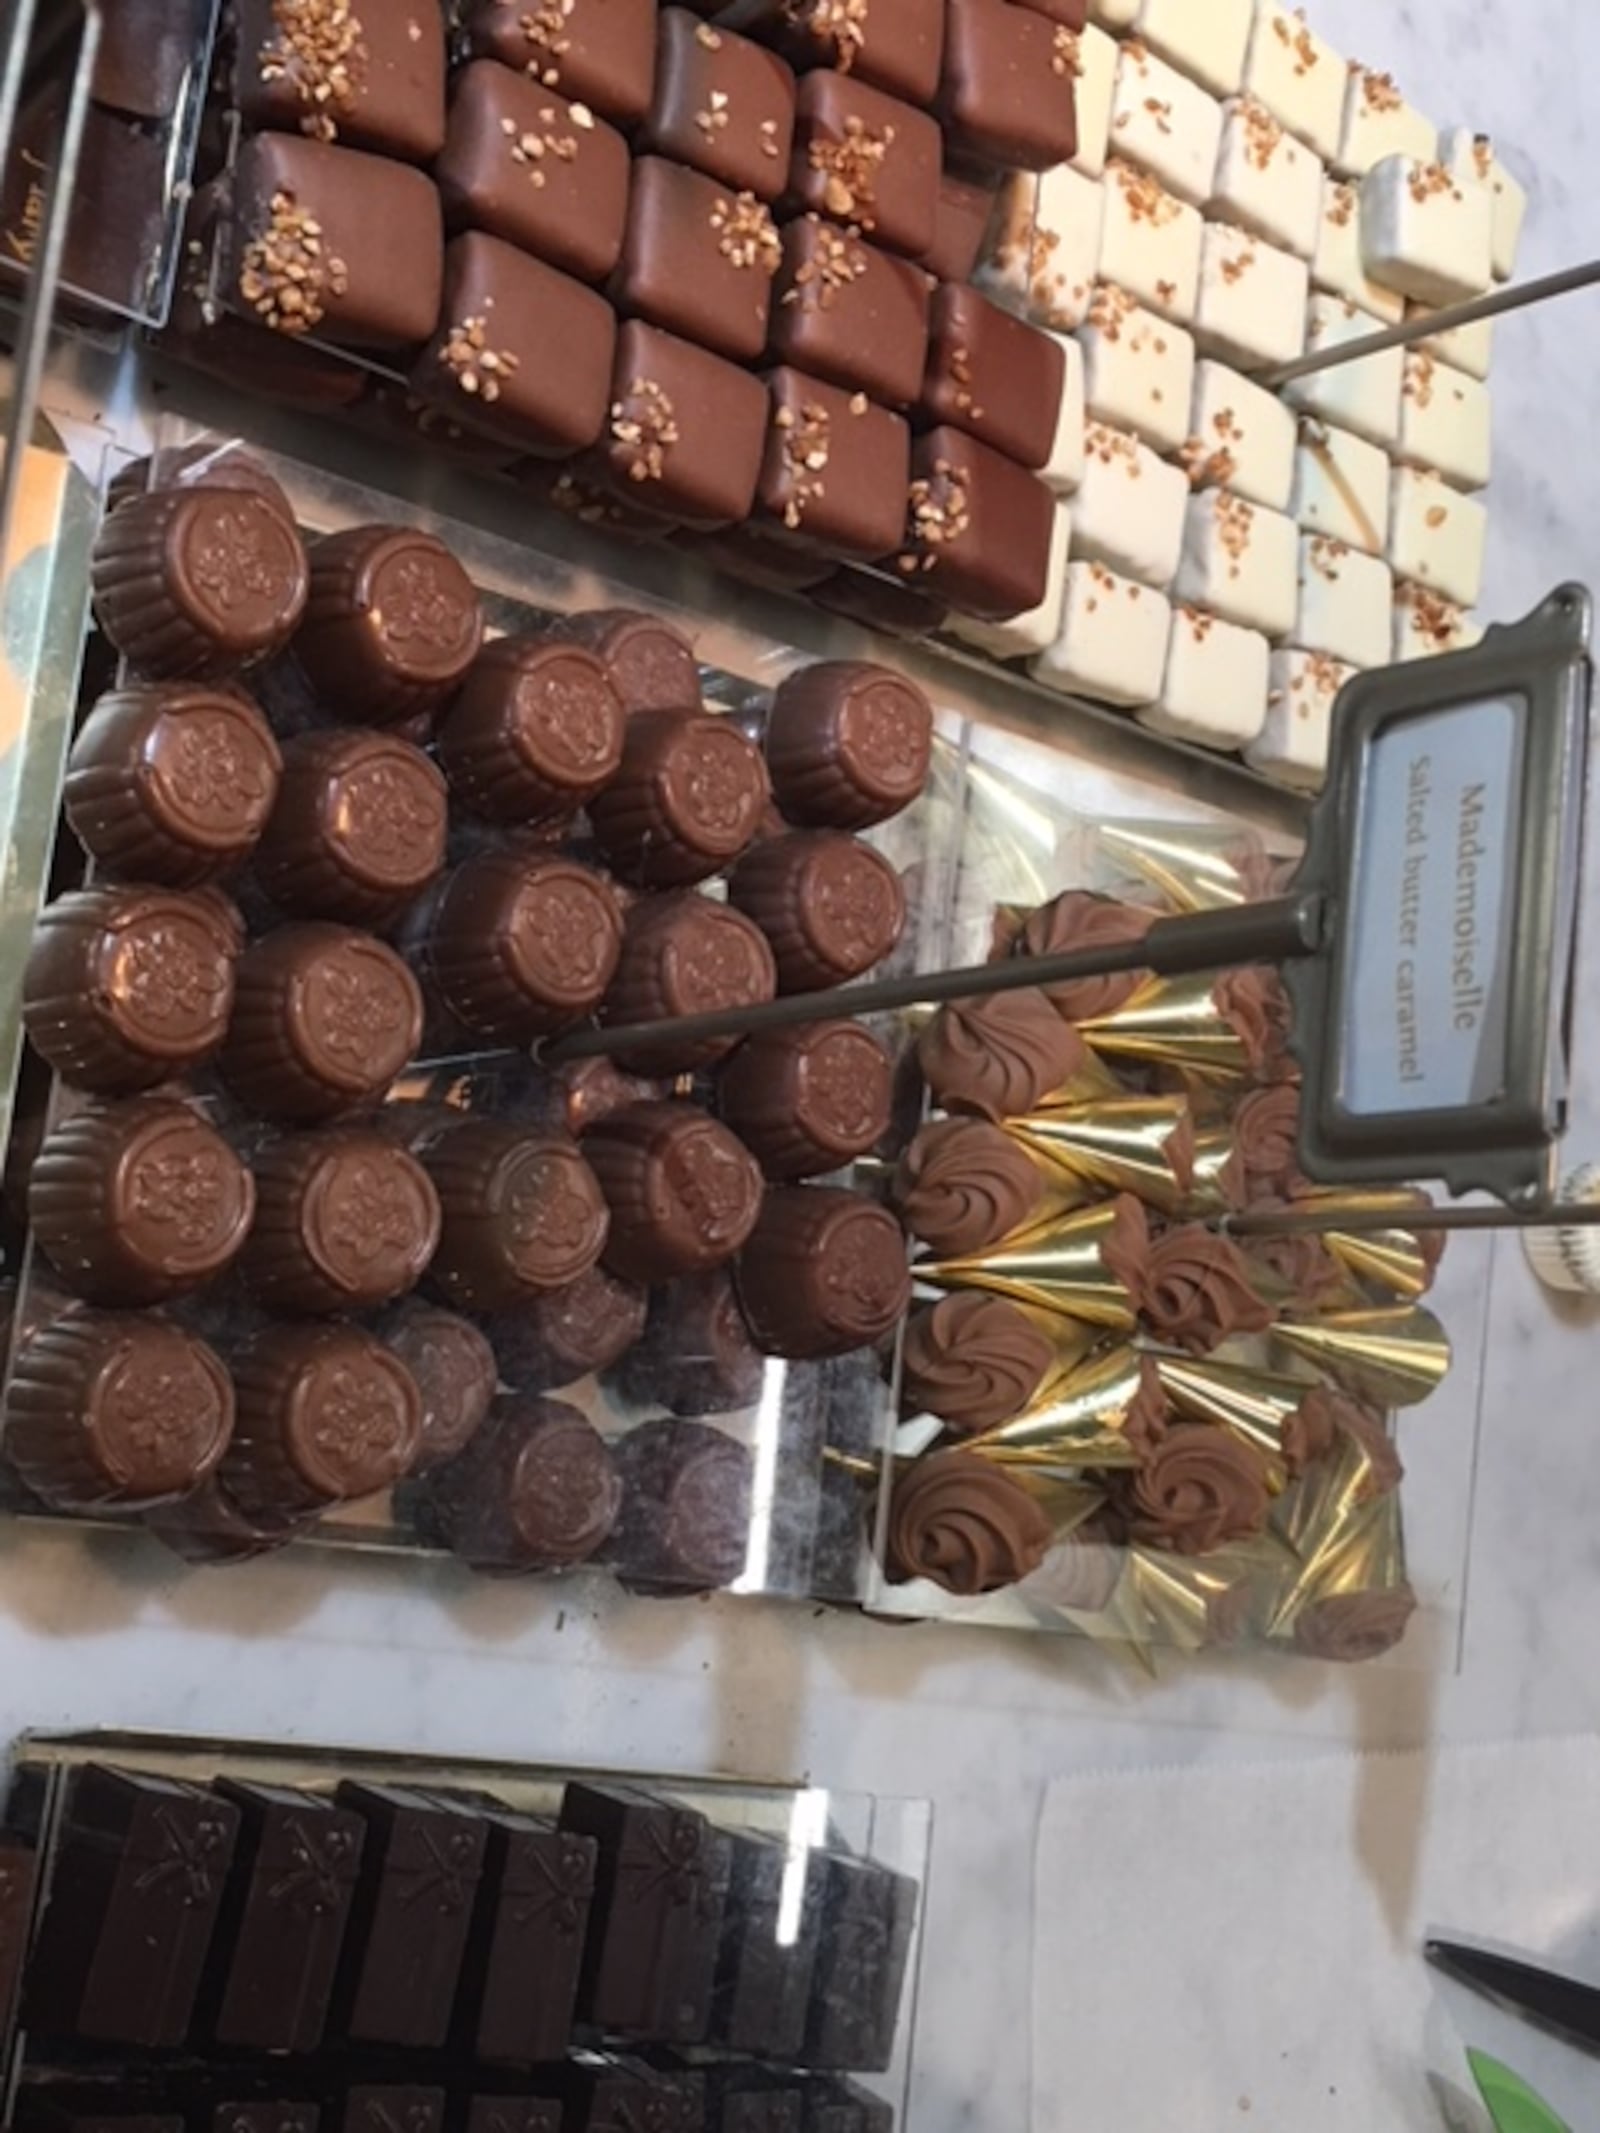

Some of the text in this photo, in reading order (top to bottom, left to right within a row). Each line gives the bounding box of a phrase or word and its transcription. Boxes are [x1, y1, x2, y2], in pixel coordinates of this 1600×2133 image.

[1396, 754, 1431, 1083] Salted butter caramel
[1453, 782, 1487, 1031] Mademoiselle
